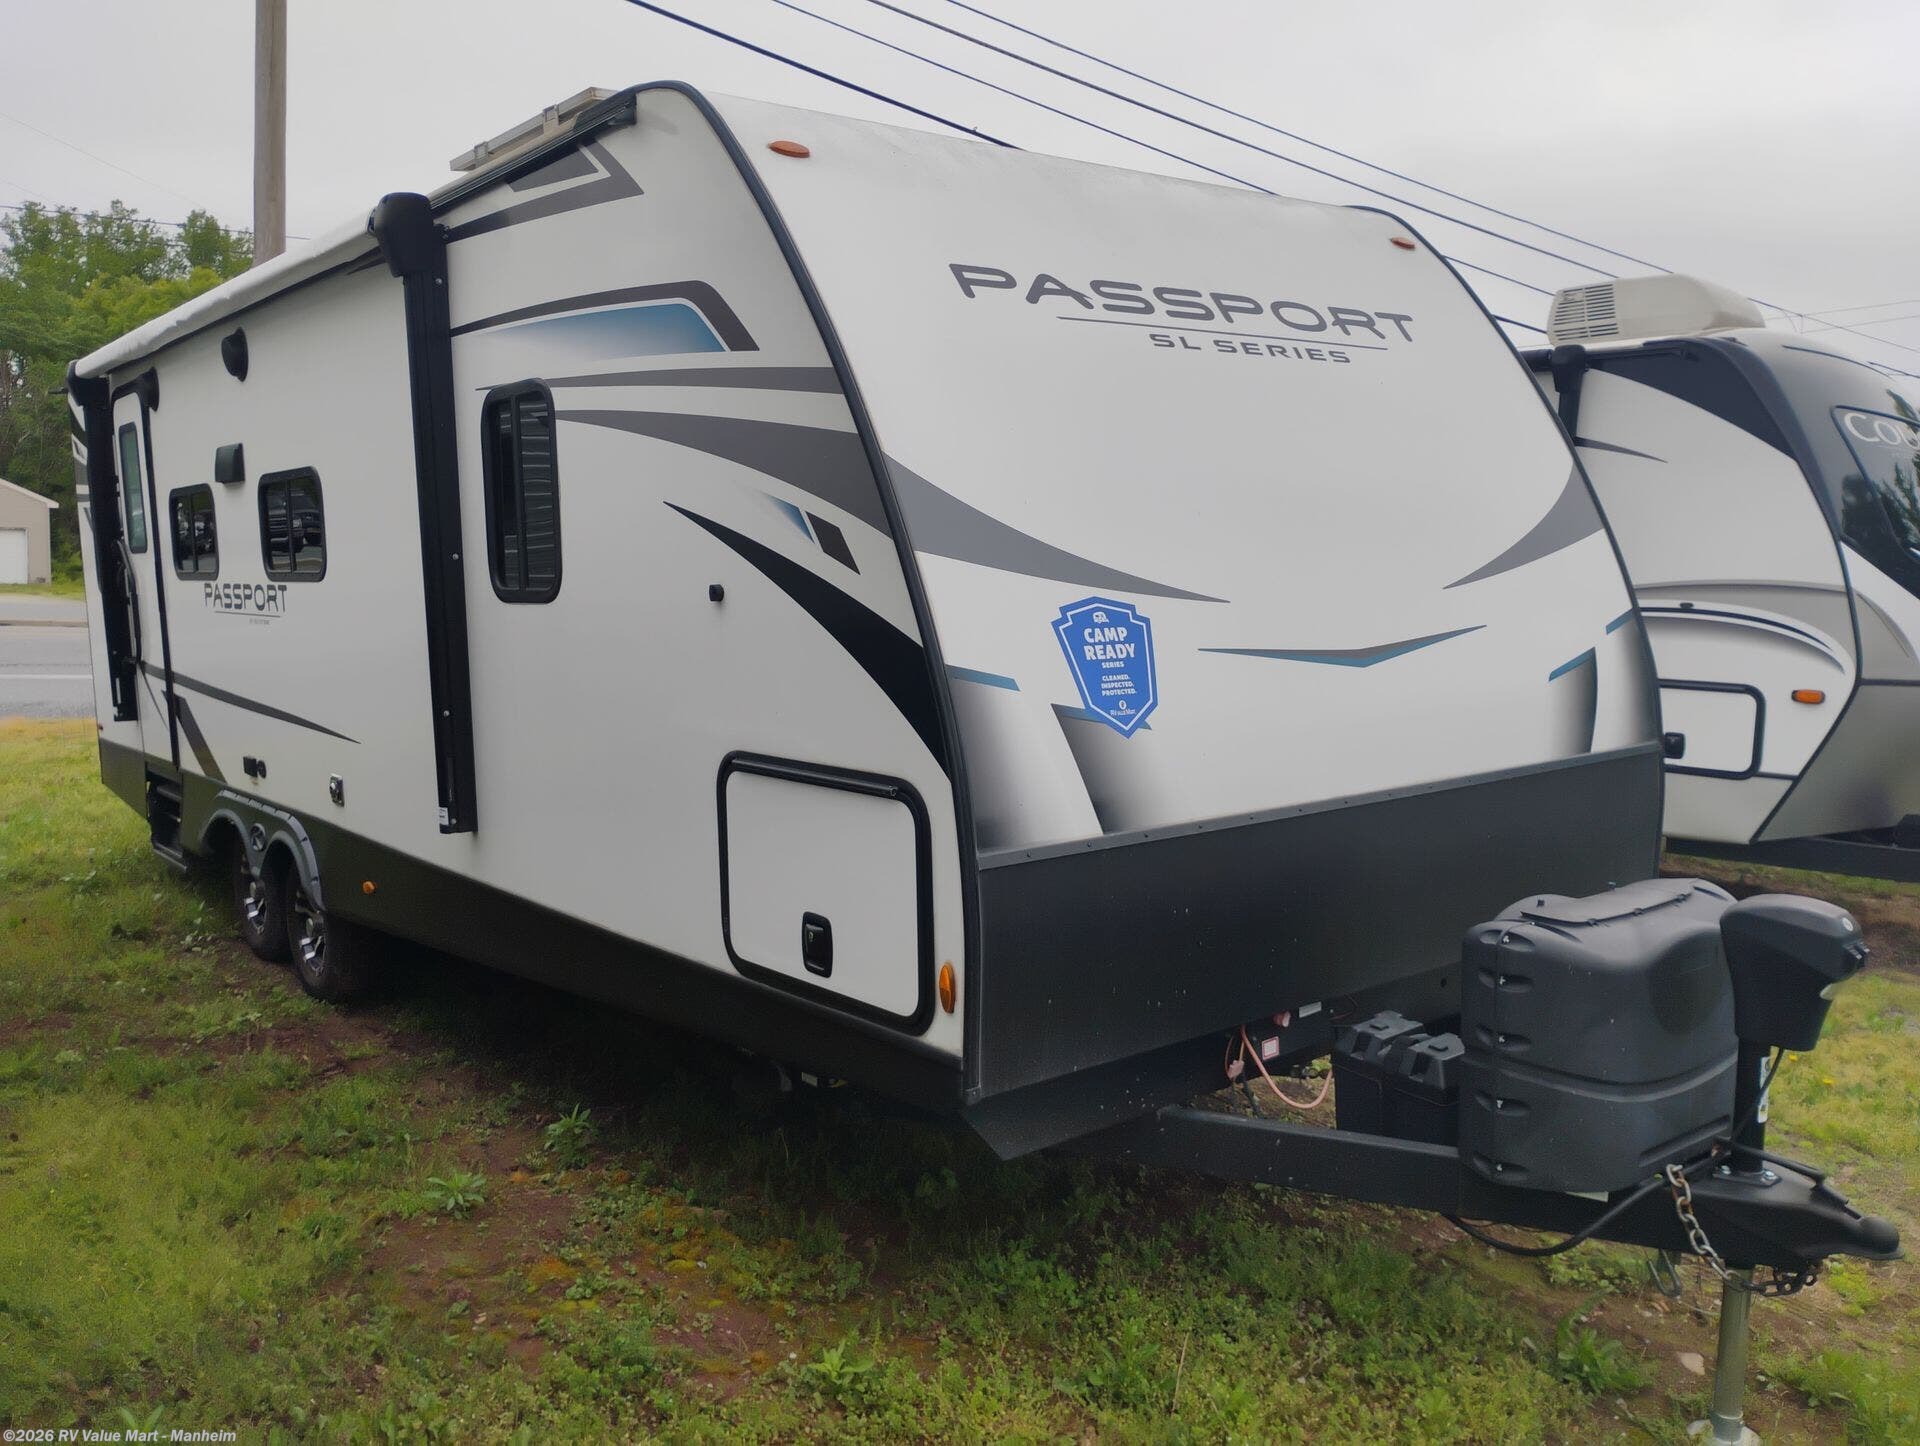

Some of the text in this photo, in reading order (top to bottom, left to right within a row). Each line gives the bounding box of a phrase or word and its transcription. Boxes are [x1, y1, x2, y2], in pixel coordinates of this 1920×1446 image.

[949, 263, 1413, 342] PASSPORT
[1149, 333, 1351, 363] SL SERIES
[204, 582, 287, 612] PASSPORT
[1083, 627, 1128, 642] CAMP
[1083, 644, 1135, 660] READY
